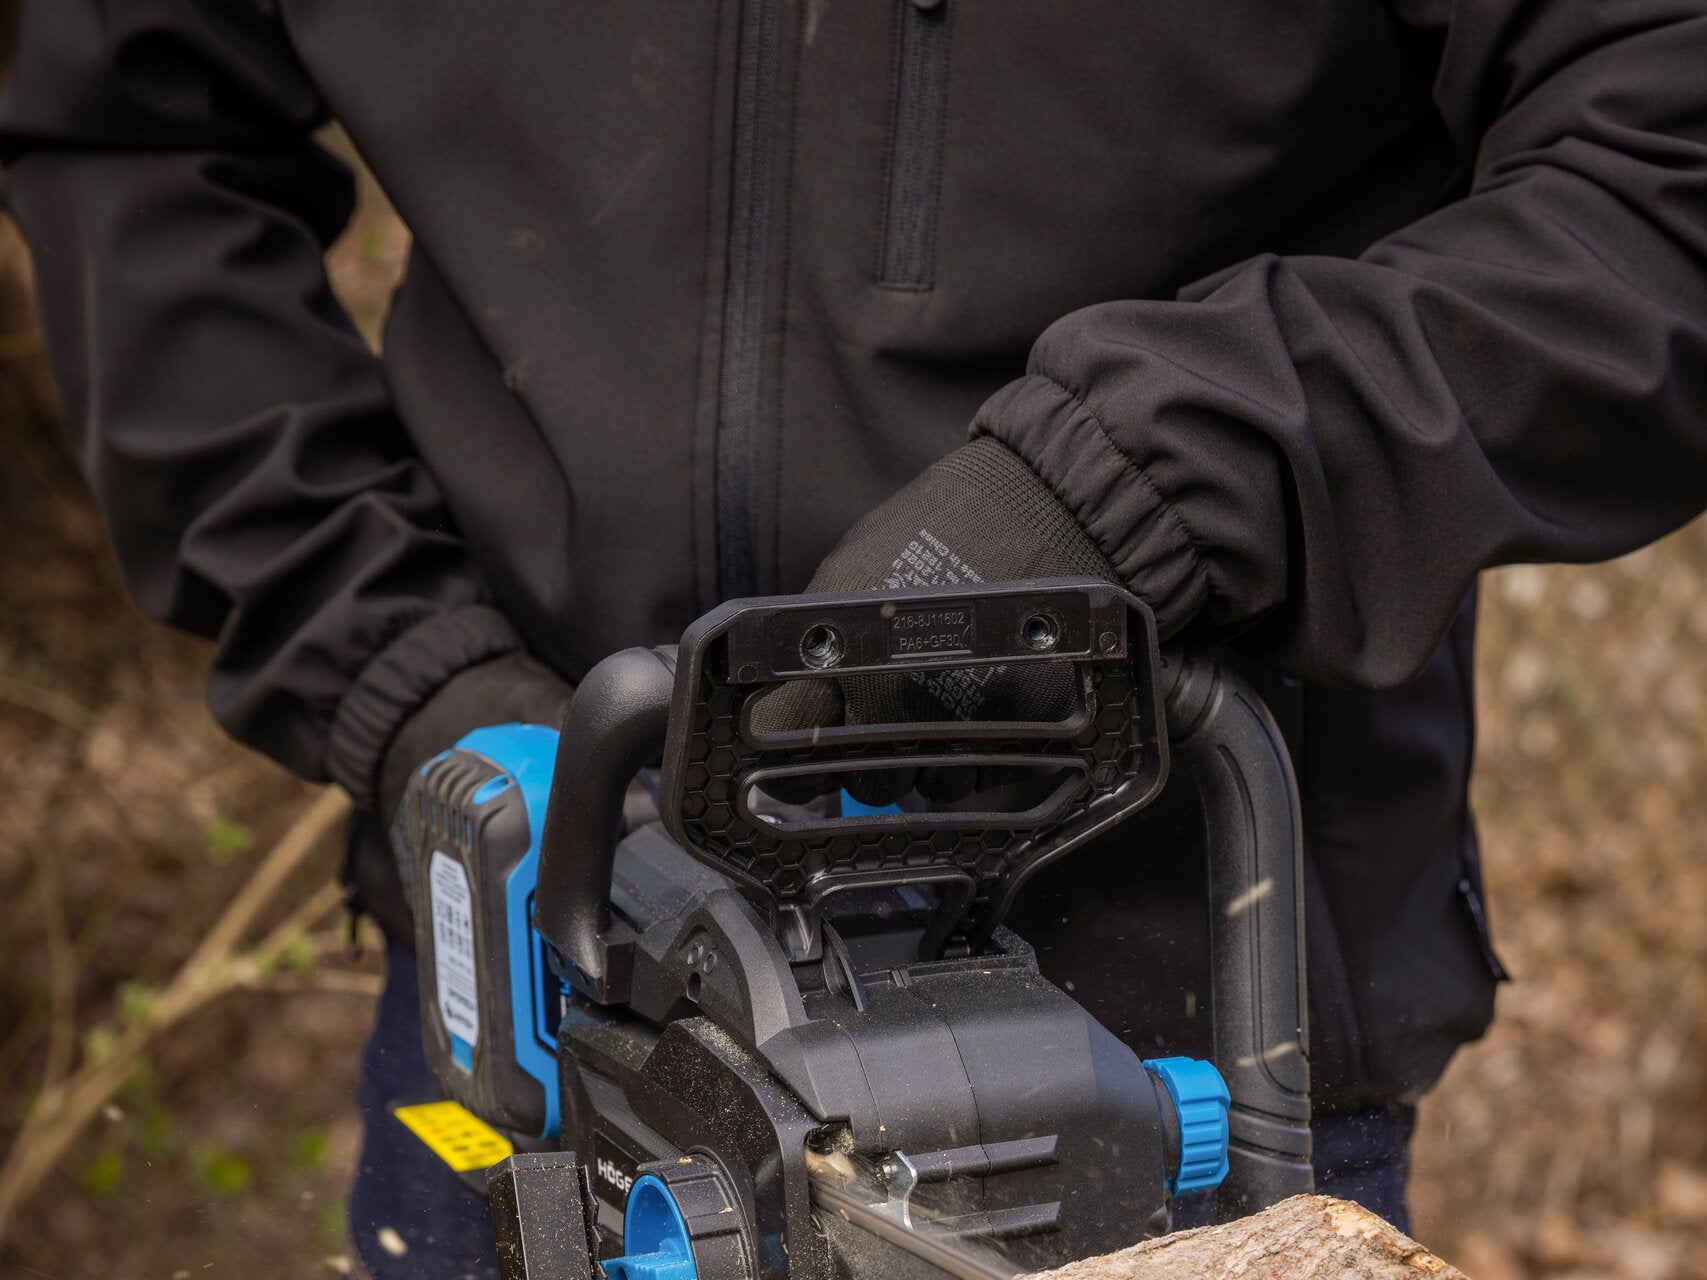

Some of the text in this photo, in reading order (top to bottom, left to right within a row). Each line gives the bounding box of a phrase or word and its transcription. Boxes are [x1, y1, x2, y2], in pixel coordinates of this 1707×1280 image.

[959, 563, 985, 583] ade
[900, 634, 960, 650] PA6+GF30
[597, 1157, 634, 1193] HÖGE
